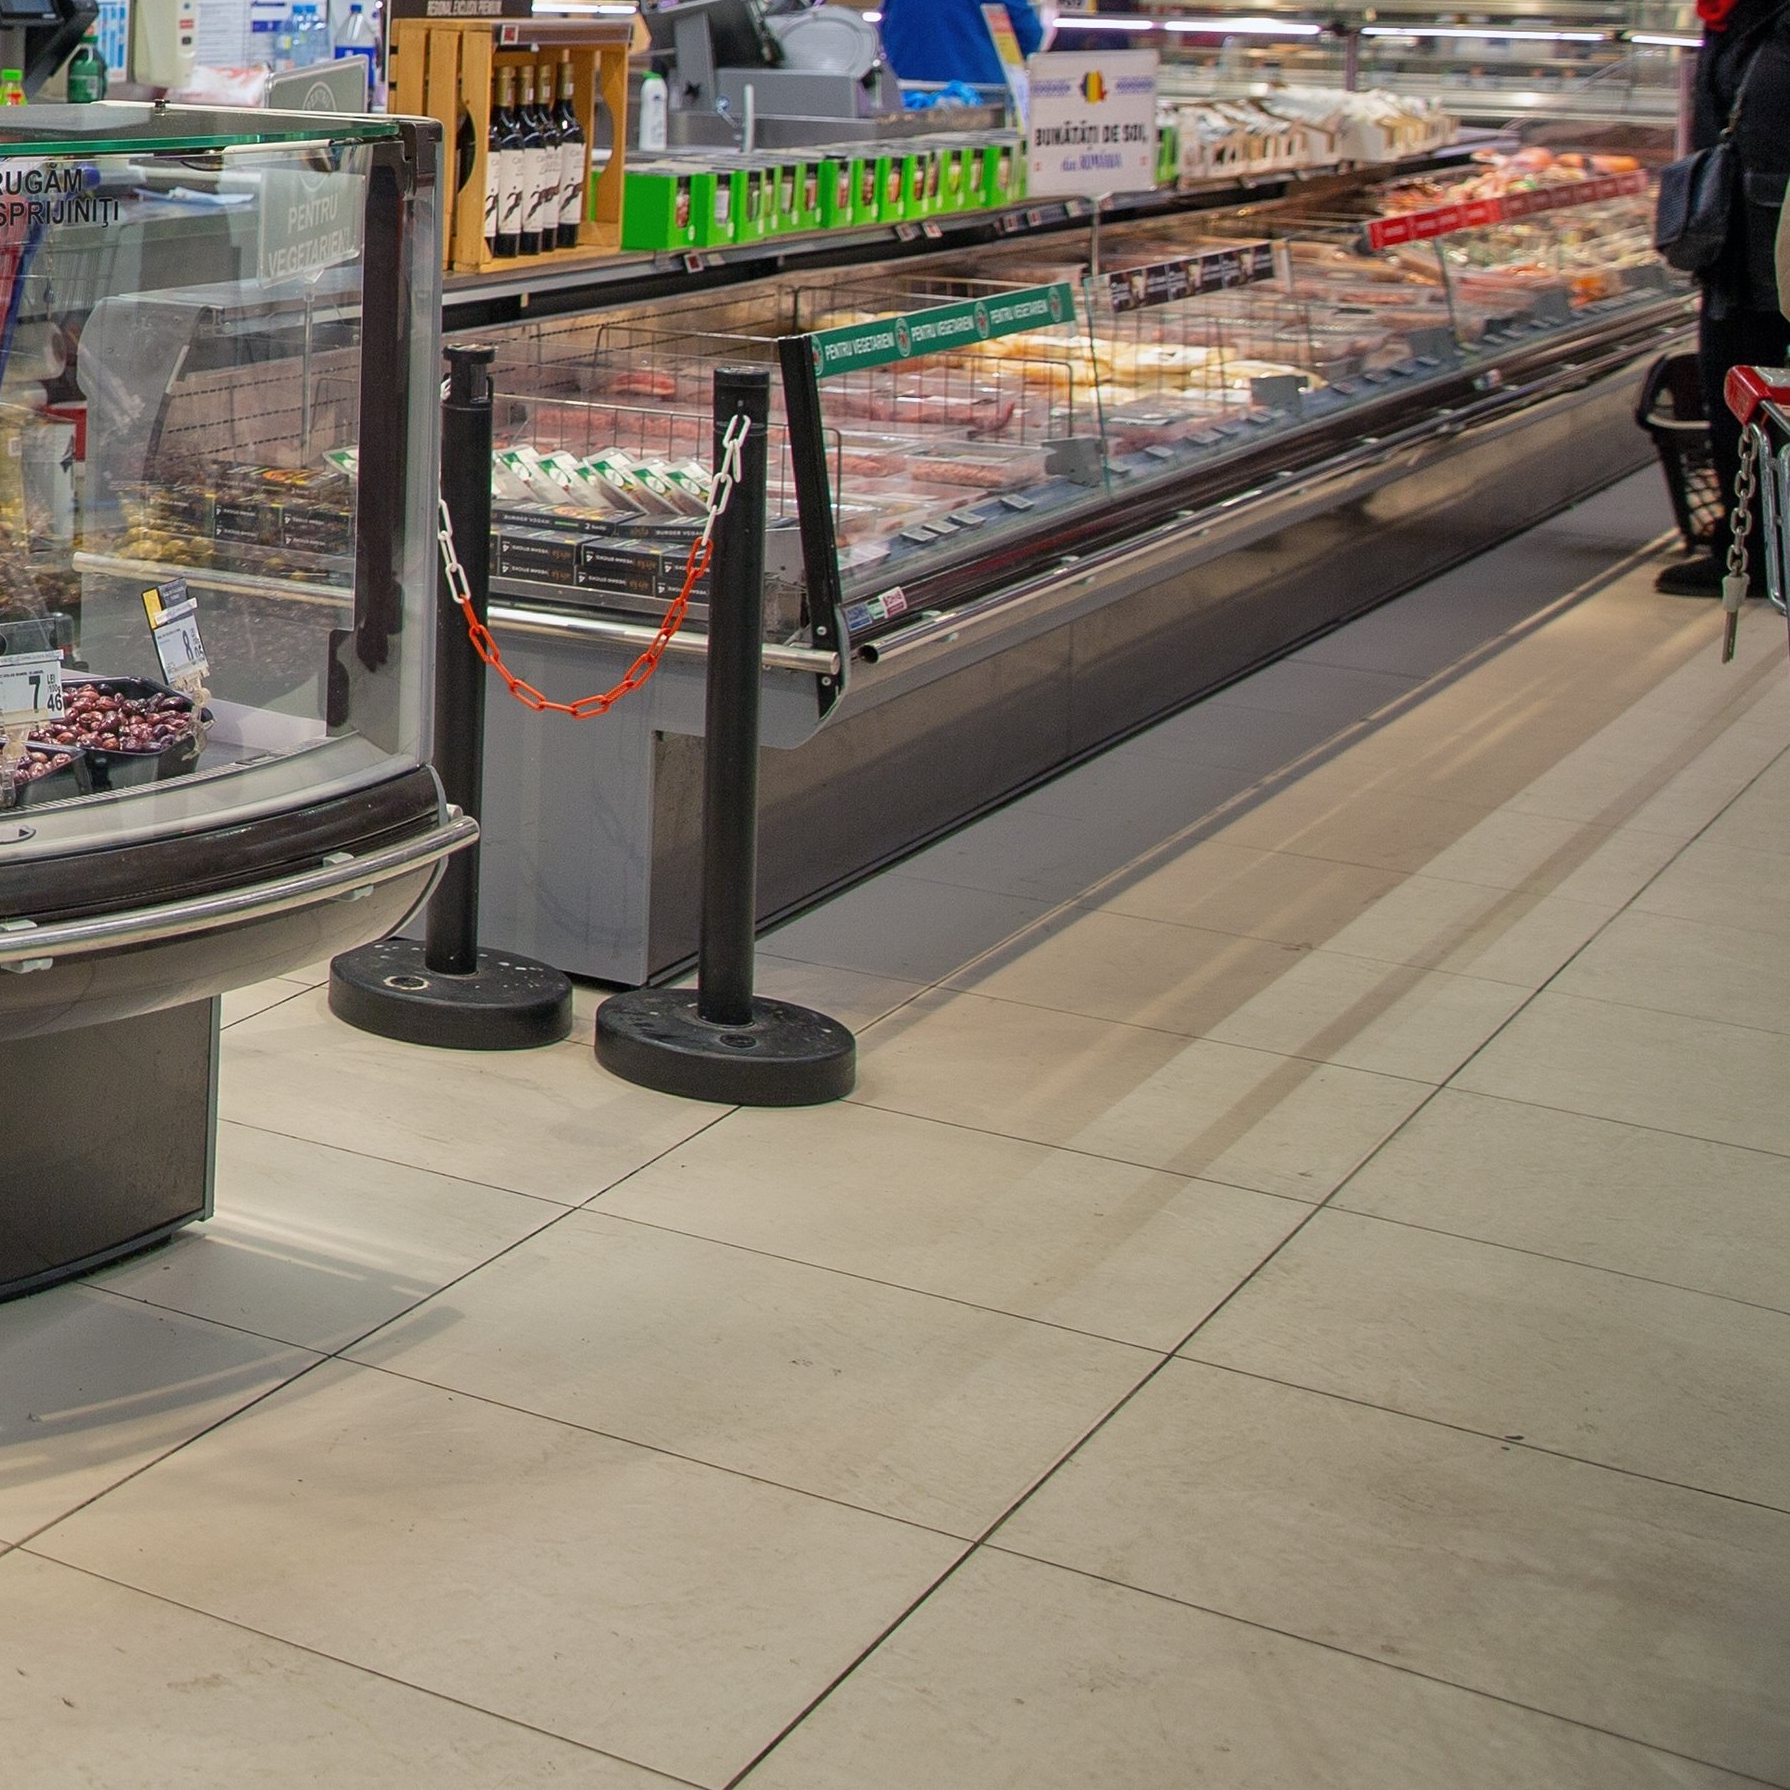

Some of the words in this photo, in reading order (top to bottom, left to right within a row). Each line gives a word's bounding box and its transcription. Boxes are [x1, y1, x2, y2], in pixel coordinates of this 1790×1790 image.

[287, 194, 340, 235] PENTRU
[910, 321, 937, 343] PENTRU
[824, 339, 853, 362] PENTRU
[182, 630, 194, 661] 8
[28, 675, 41, 714] 7
[46, 673, 57, 685] LEI
[46, 693, 63, 713] 46
